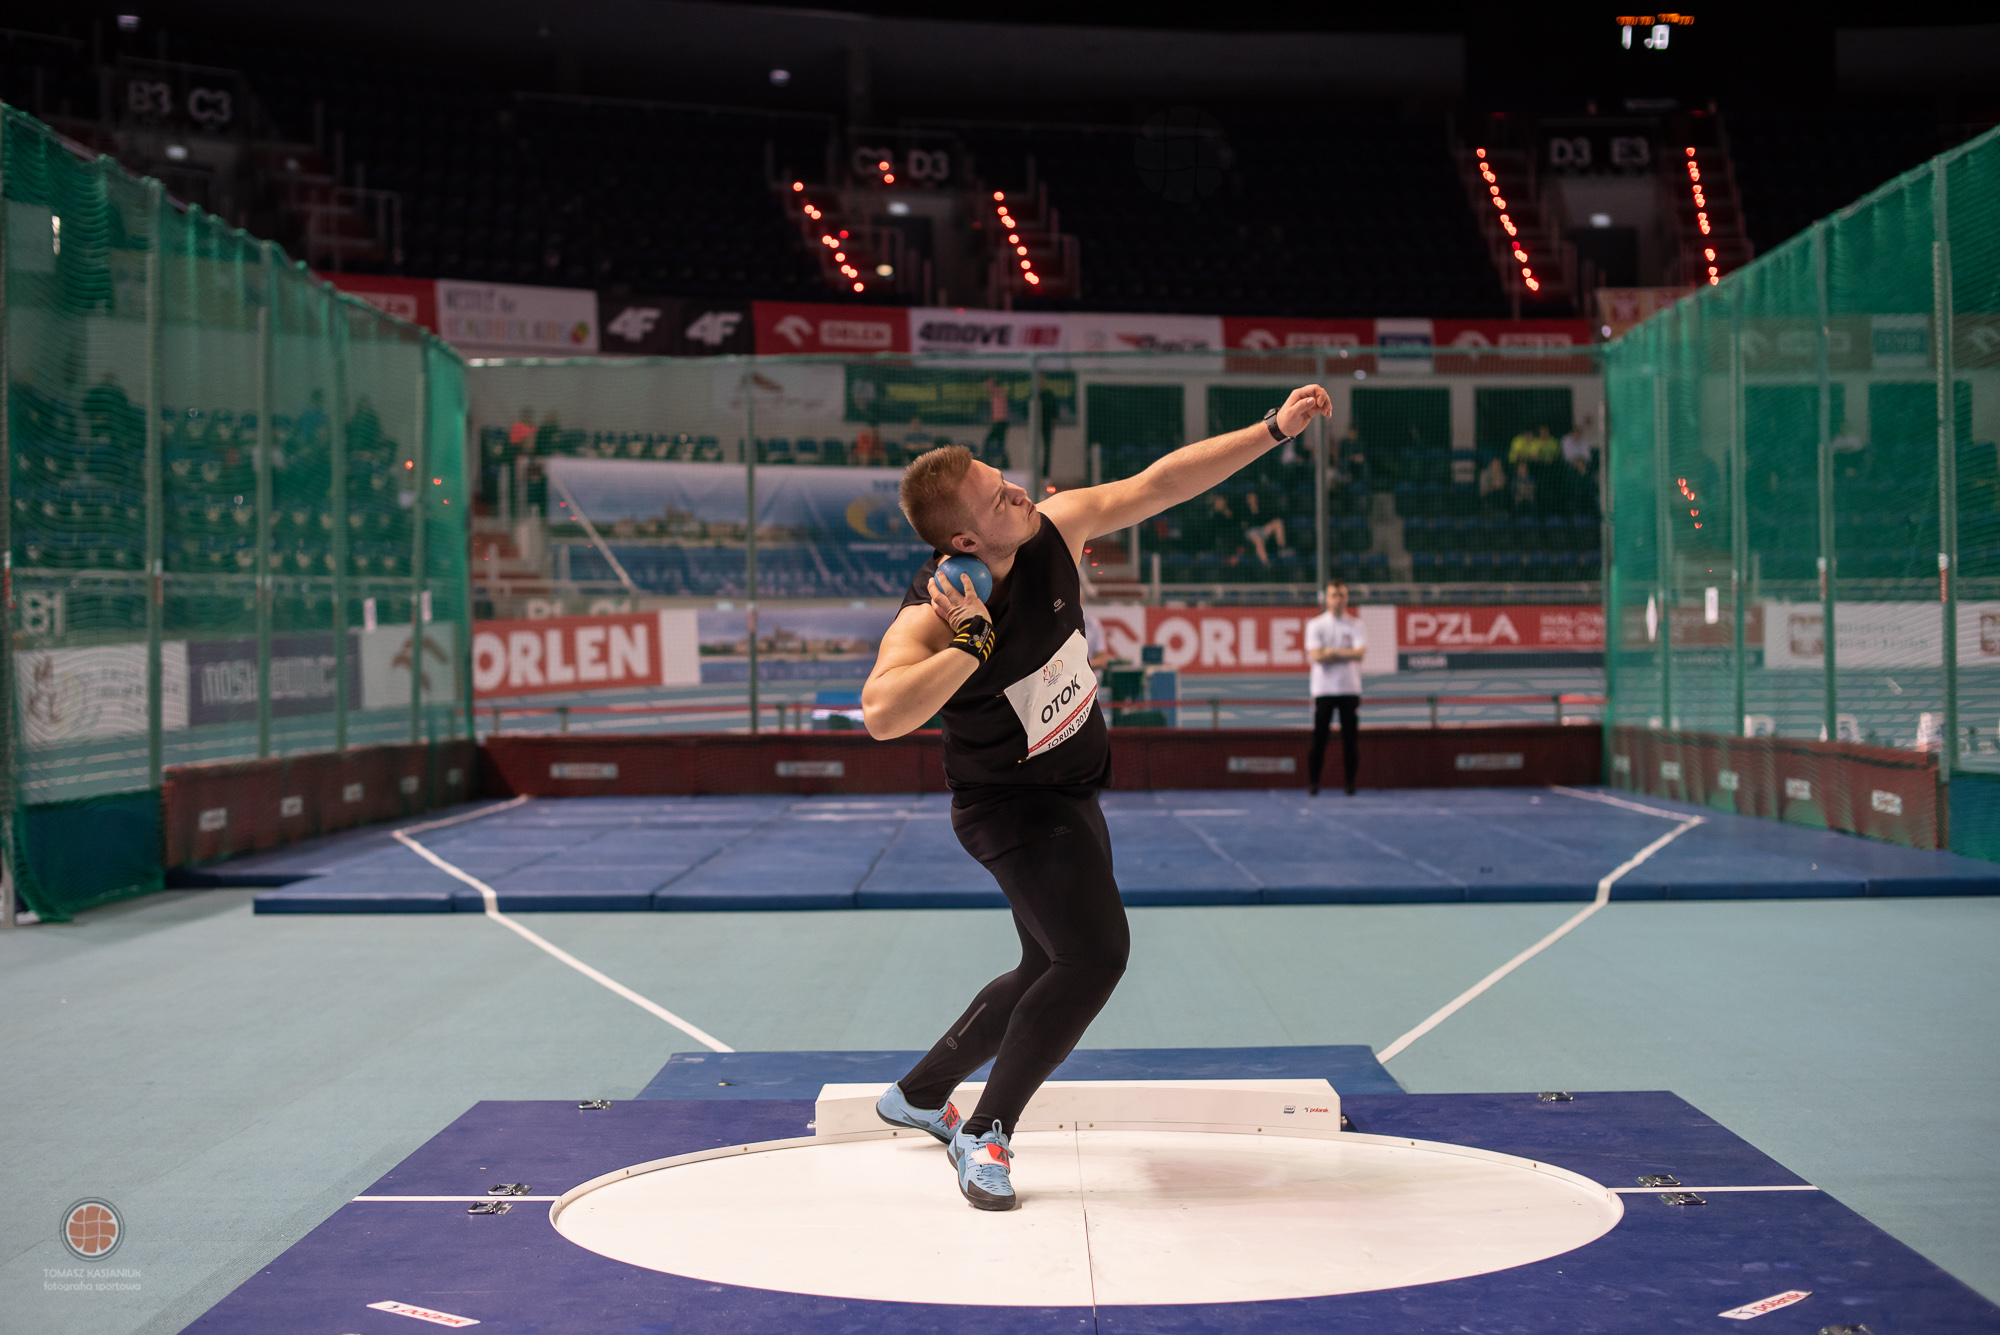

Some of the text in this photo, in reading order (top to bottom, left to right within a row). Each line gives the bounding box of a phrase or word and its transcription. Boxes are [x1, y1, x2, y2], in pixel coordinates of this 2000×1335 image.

[907, 149, 949, 180] D3
[1550, 137, 1649, 166] D3 E3
[607, 306, 661, 341] 4F
[686, 311, 742, 345] 4F
[1154, 616, 1310, 667] ORLE
[1405, 612, 1521, 644] PZLA
[472, 624, 650, 691] ORLEN
[1041, 674, 1081, 724] OTOK
[1047, 706, 1090, 748] TORUŃ 2019
